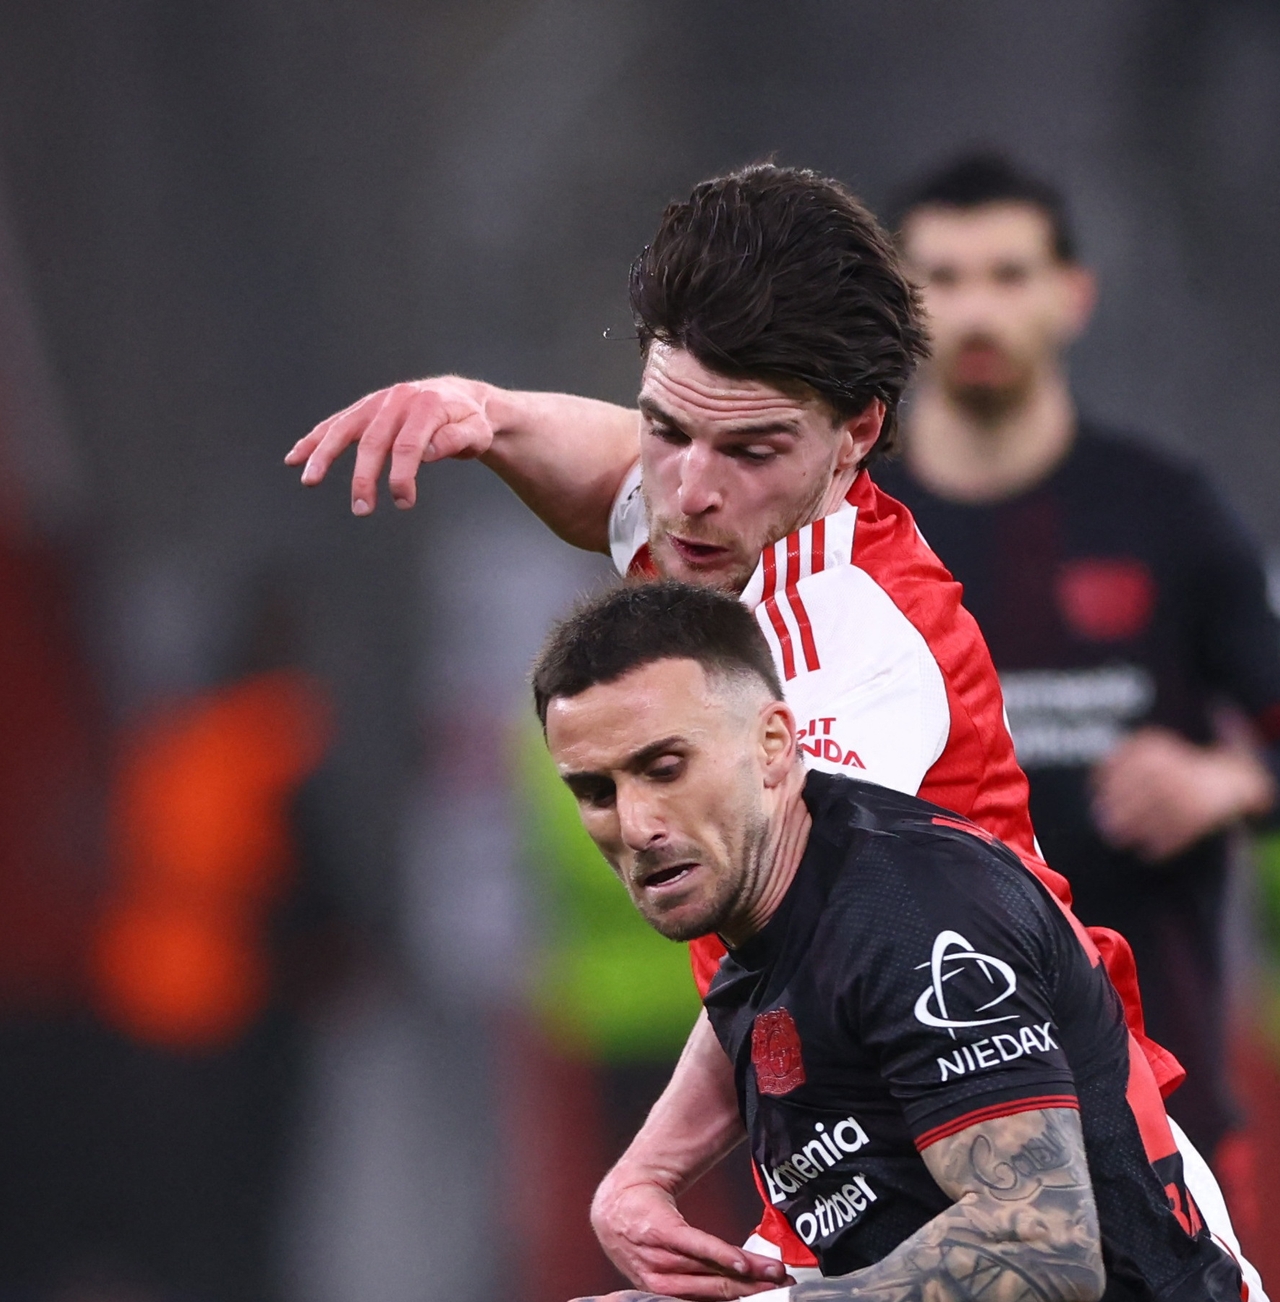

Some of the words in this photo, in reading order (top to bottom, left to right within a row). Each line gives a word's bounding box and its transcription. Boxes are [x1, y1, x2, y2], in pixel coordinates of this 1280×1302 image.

[800, 738, 867, 770] NDA
[936, 1021, 1059, 1082] NIEDAX
[795, 1172, 878, 1246] othaer
